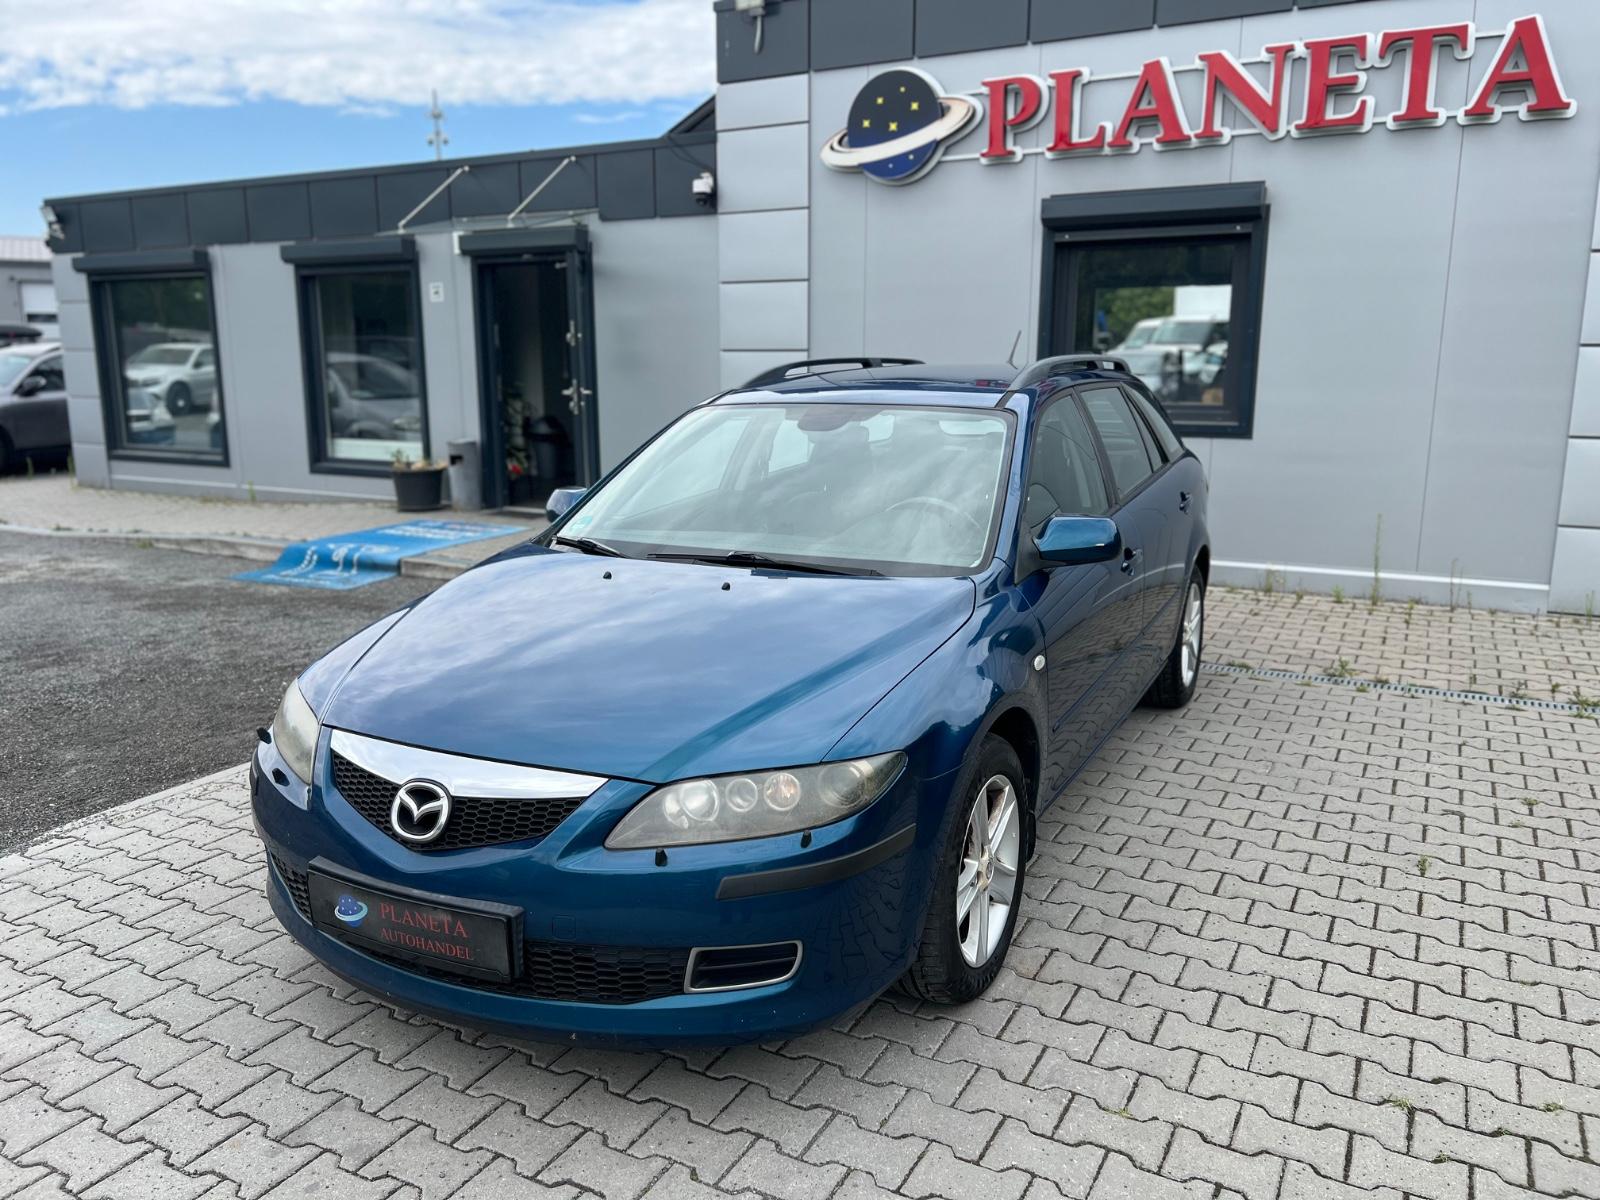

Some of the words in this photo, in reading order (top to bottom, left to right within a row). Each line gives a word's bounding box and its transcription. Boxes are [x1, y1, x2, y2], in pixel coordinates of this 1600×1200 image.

[980, 15, 1575, 160] PLANETA
[380, 902, 468, 938] PLANETA
[381, 928, 474, 961] AUTOHANDEL
